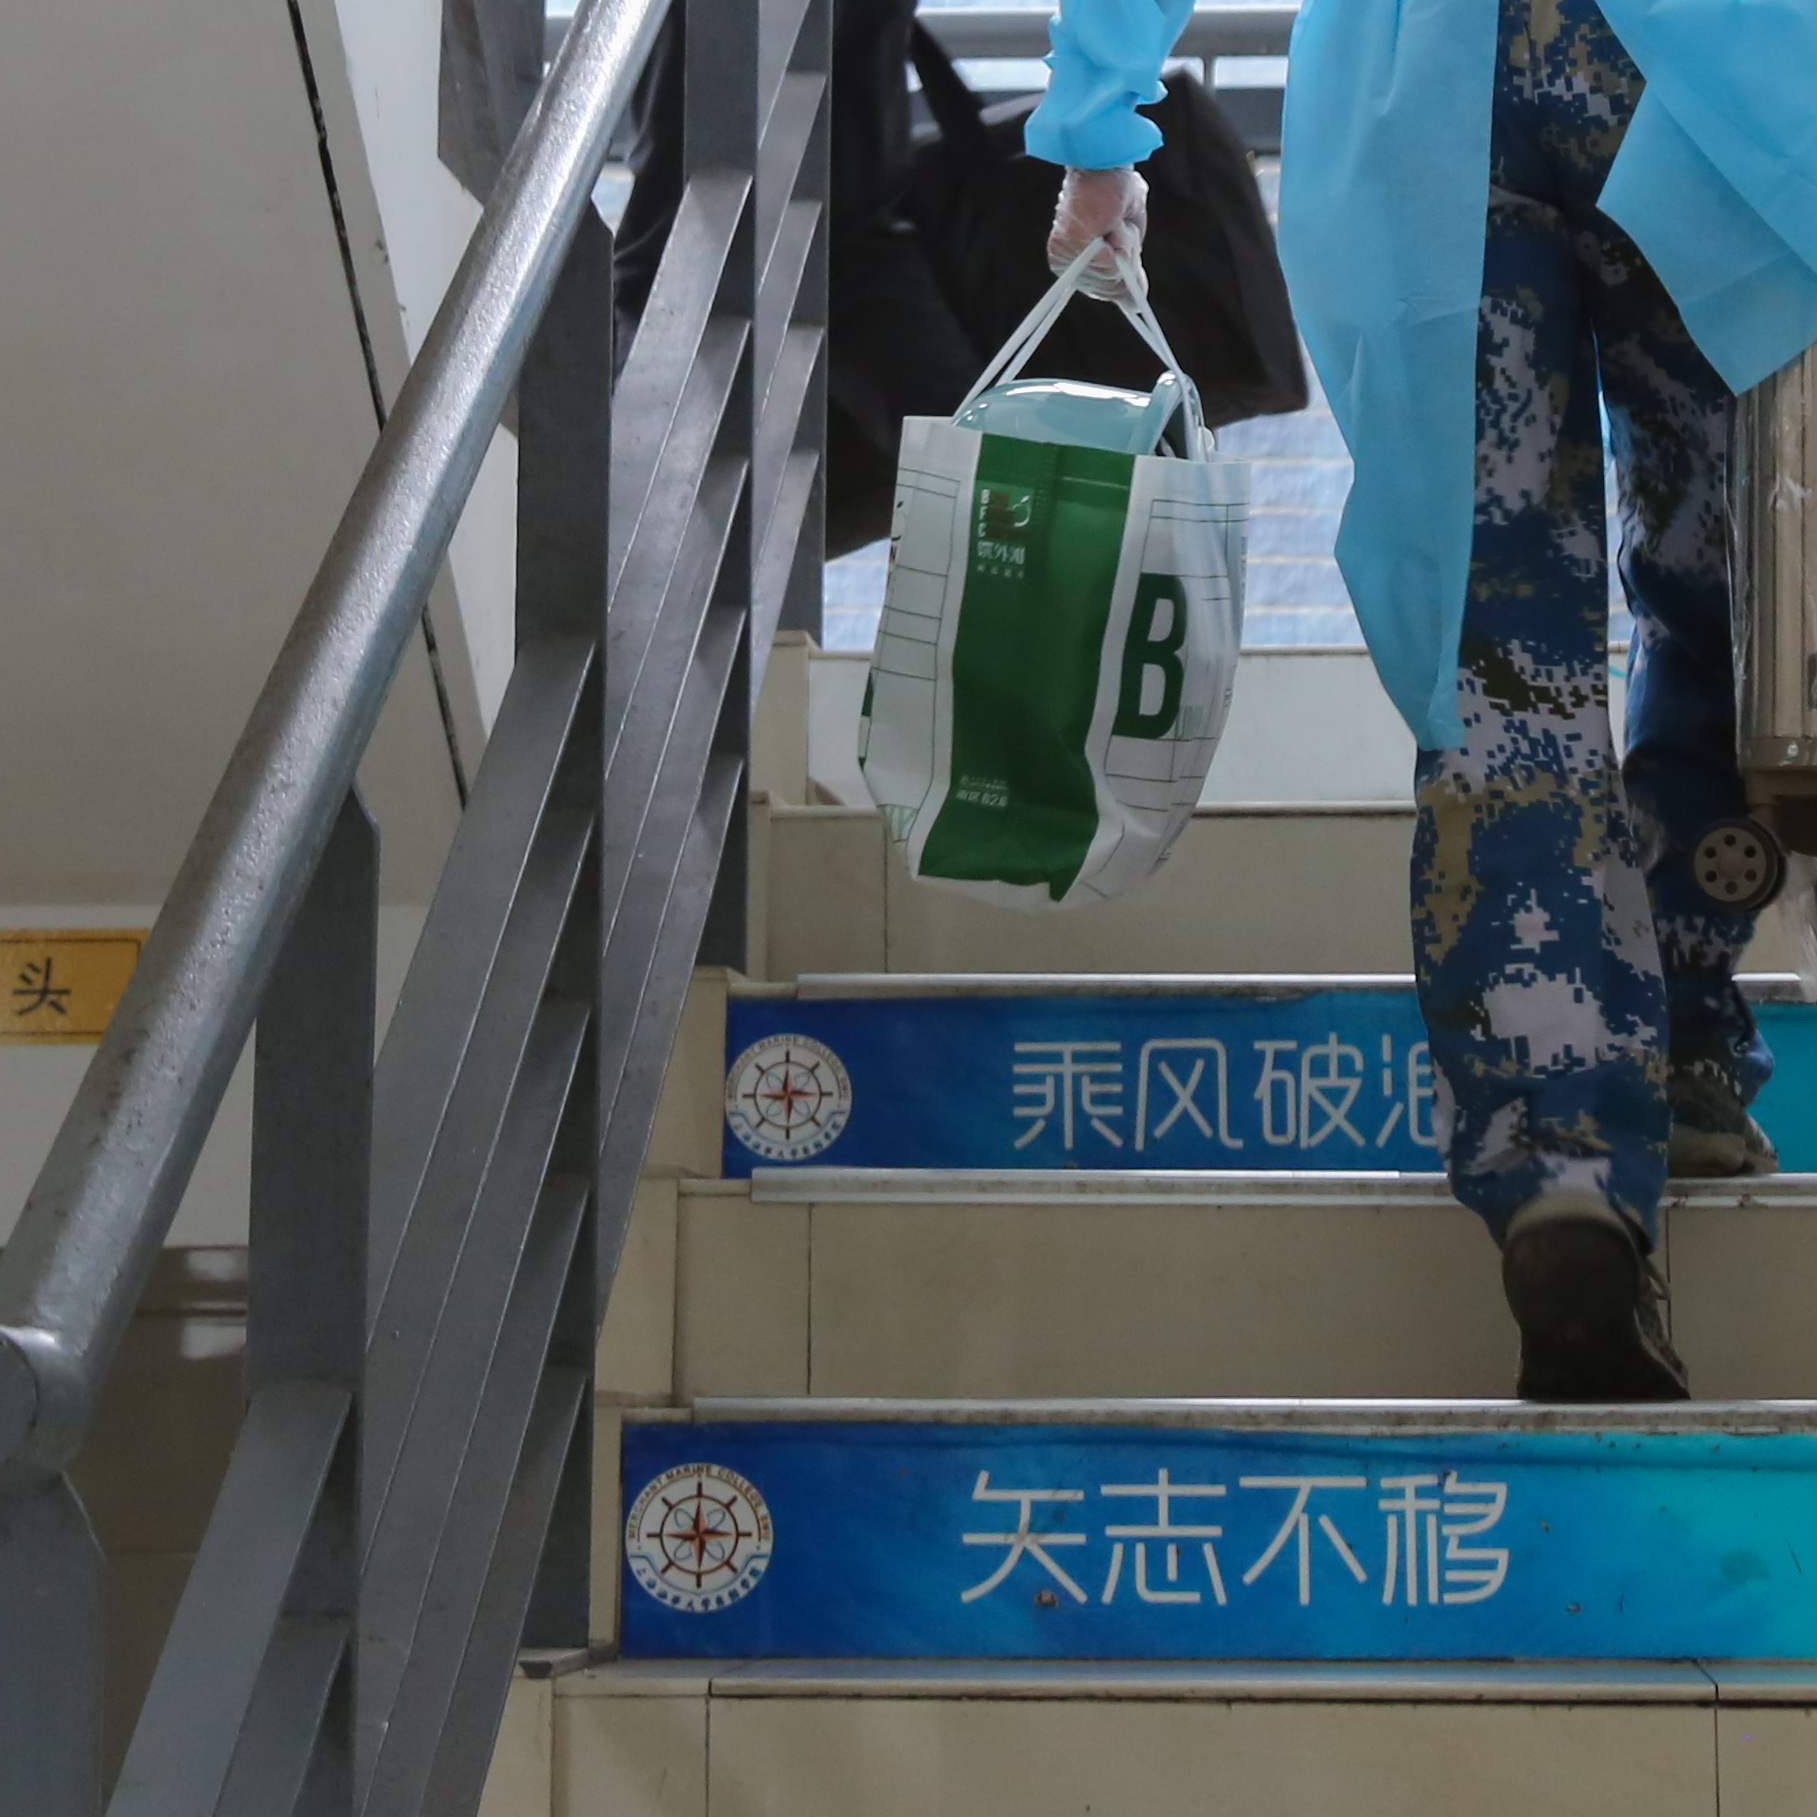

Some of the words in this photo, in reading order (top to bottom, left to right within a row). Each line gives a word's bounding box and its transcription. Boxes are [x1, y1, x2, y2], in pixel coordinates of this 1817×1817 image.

[1112, 573, 1187, 739] B
[961, 1468, 1510, 1606] 矢志不移
